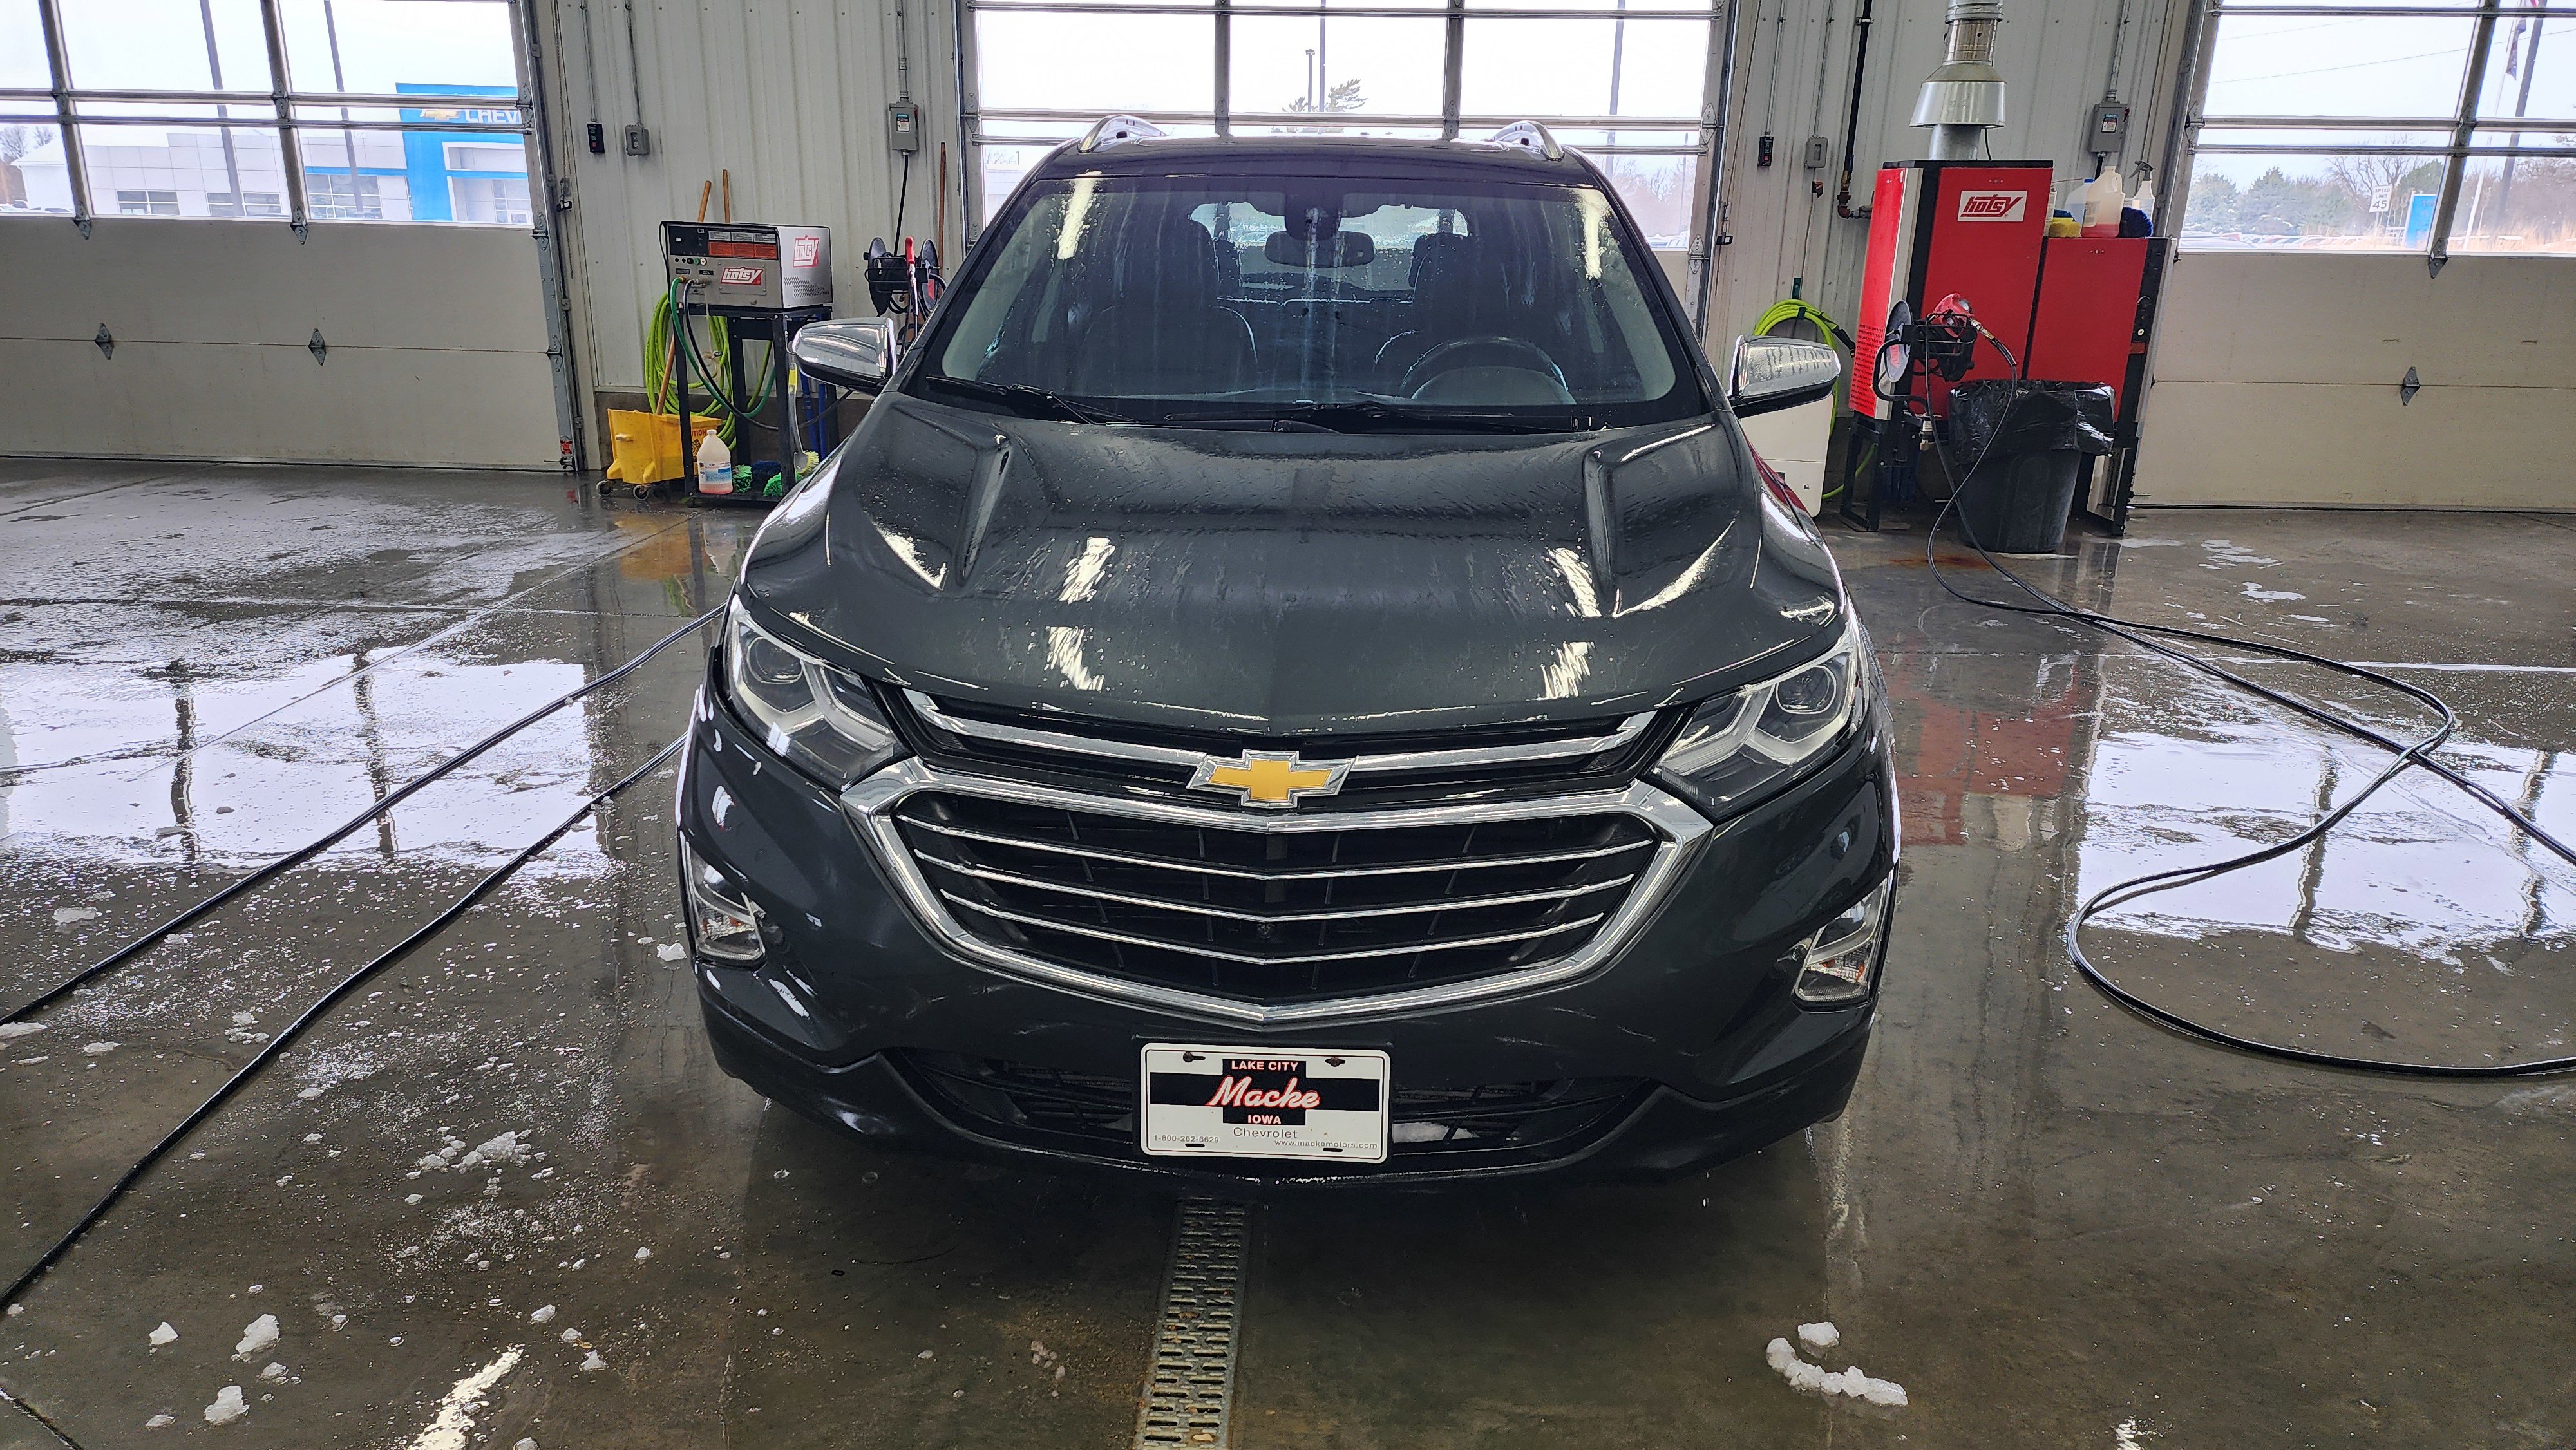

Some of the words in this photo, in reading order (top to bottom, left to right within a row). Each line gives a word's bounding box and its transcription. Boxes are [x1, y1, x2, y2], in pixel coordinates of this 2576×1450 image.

[465, 109, 522, 124] CHEV
[1960, 194, 2023, 217] hotsy
[2372, 200, 2387, 209] 45
[721, 267, 763, 284] hotsy
[1231, 1060, 1264, 1070] LAKE
[1268, 1062, 1298, 1071] CITY
[1206, 1075, 1321, 1109] Macke
[1247, 1115, 1282, 1124] IOWA
[1233, 1127, 1297, 1138] Chevrolet
[1154, 1135, 1219, 1143] 1-800-262-6629
[1274, 1140, 1378, 1149] www.mackemotors.com
